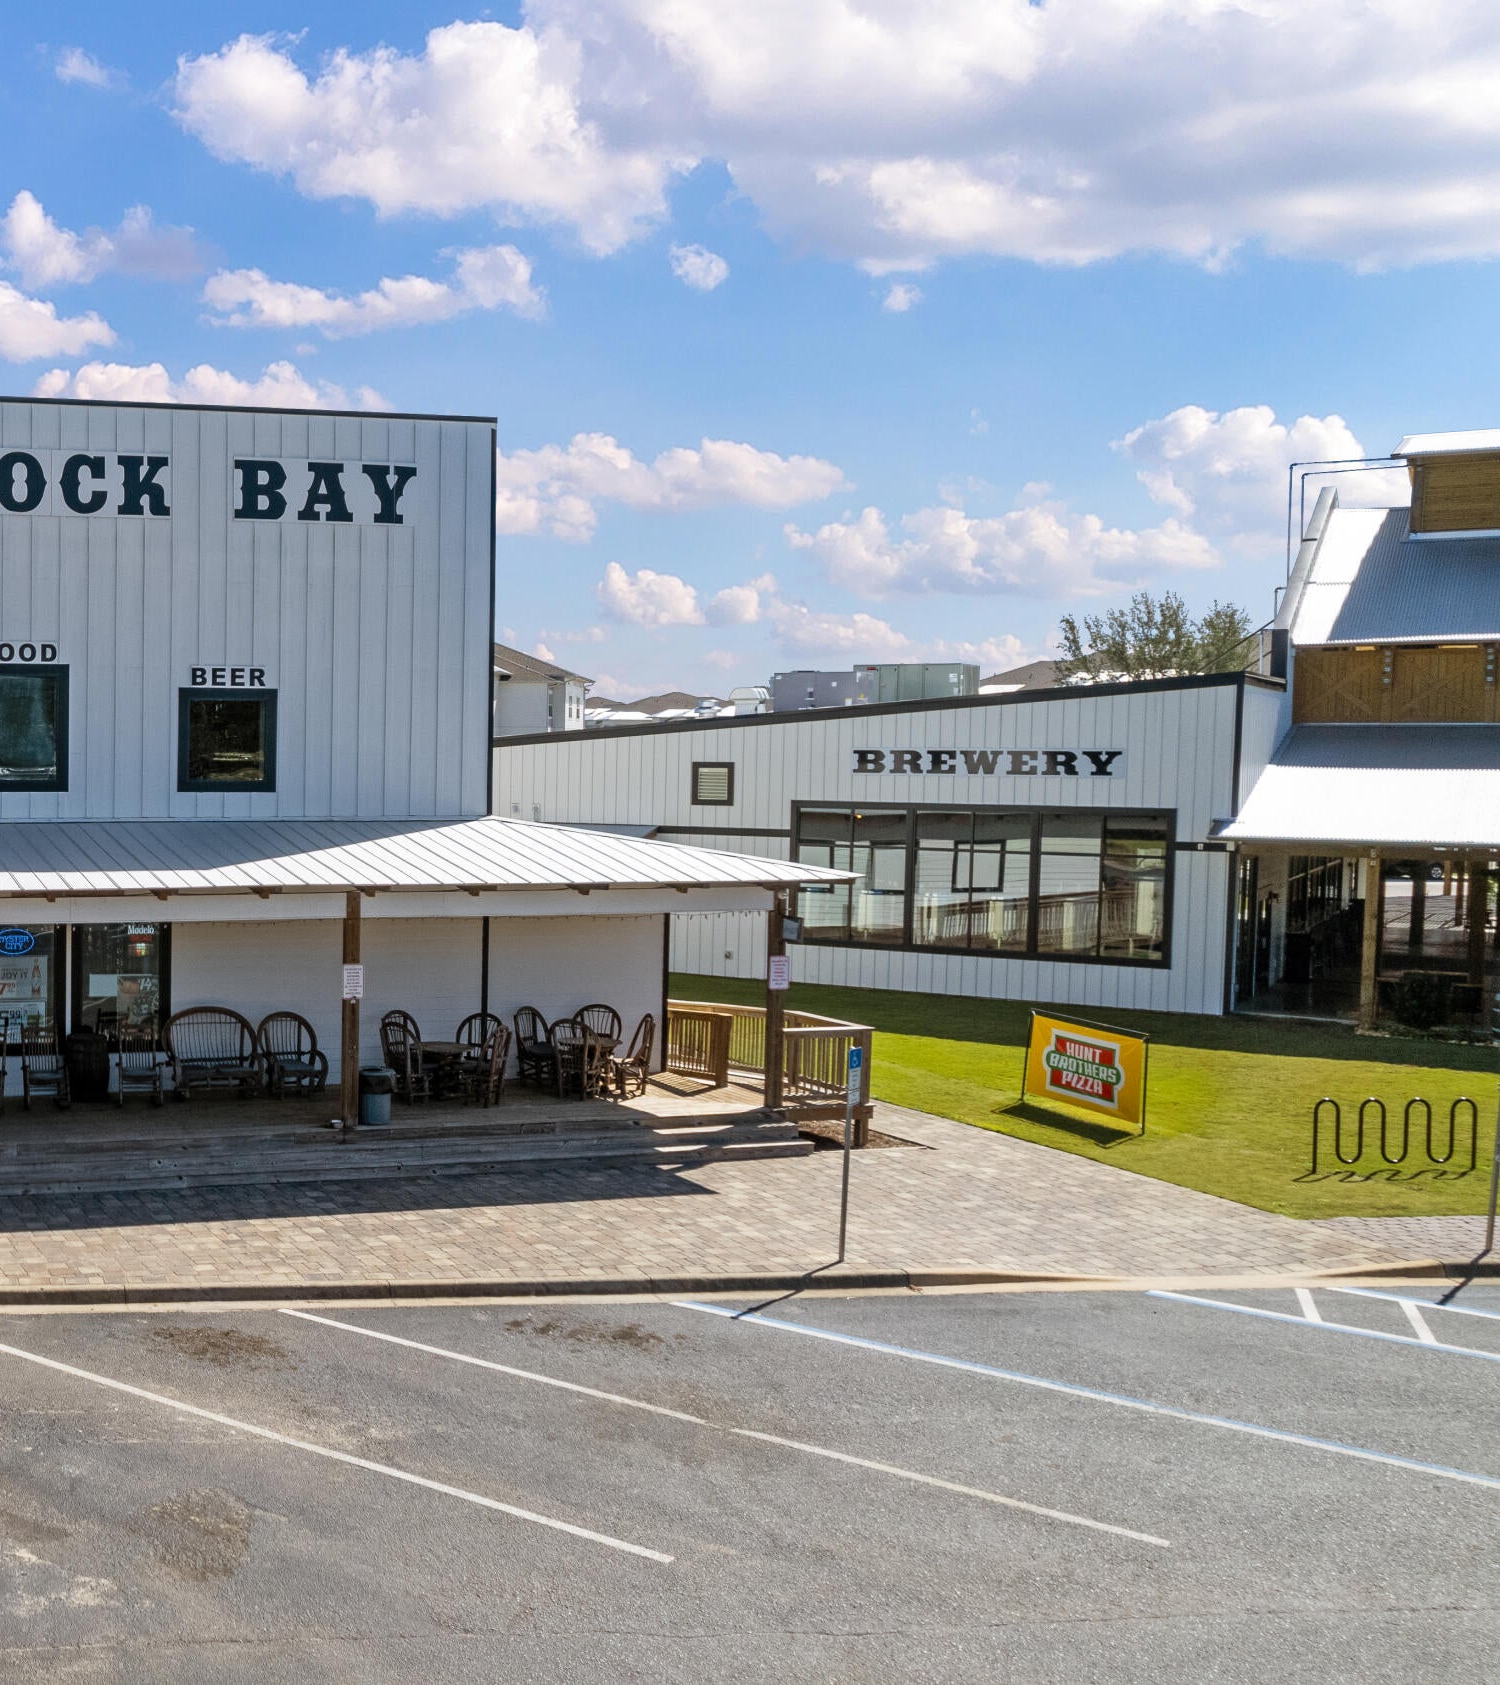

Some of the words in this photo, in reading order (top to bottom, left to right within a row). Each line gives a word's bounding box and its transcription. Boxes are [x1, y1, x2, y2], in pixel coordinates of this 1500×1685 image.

[233, 460, 417, 523] BAY
[191, 667, 266, 687] BEER
[852, 750, 1122, 776] BREWERY
[0, 935, 29, 943] OYSTER
[128, 925, 154, 935] Modelo
[5, 942, 24, 950] CITY
[1066, 1041, 1102, 1063] HUNT
[1049, 1053, 1117, 1083] BROTHERS
[1061, 1071, 1102, 1095] PIZZA
